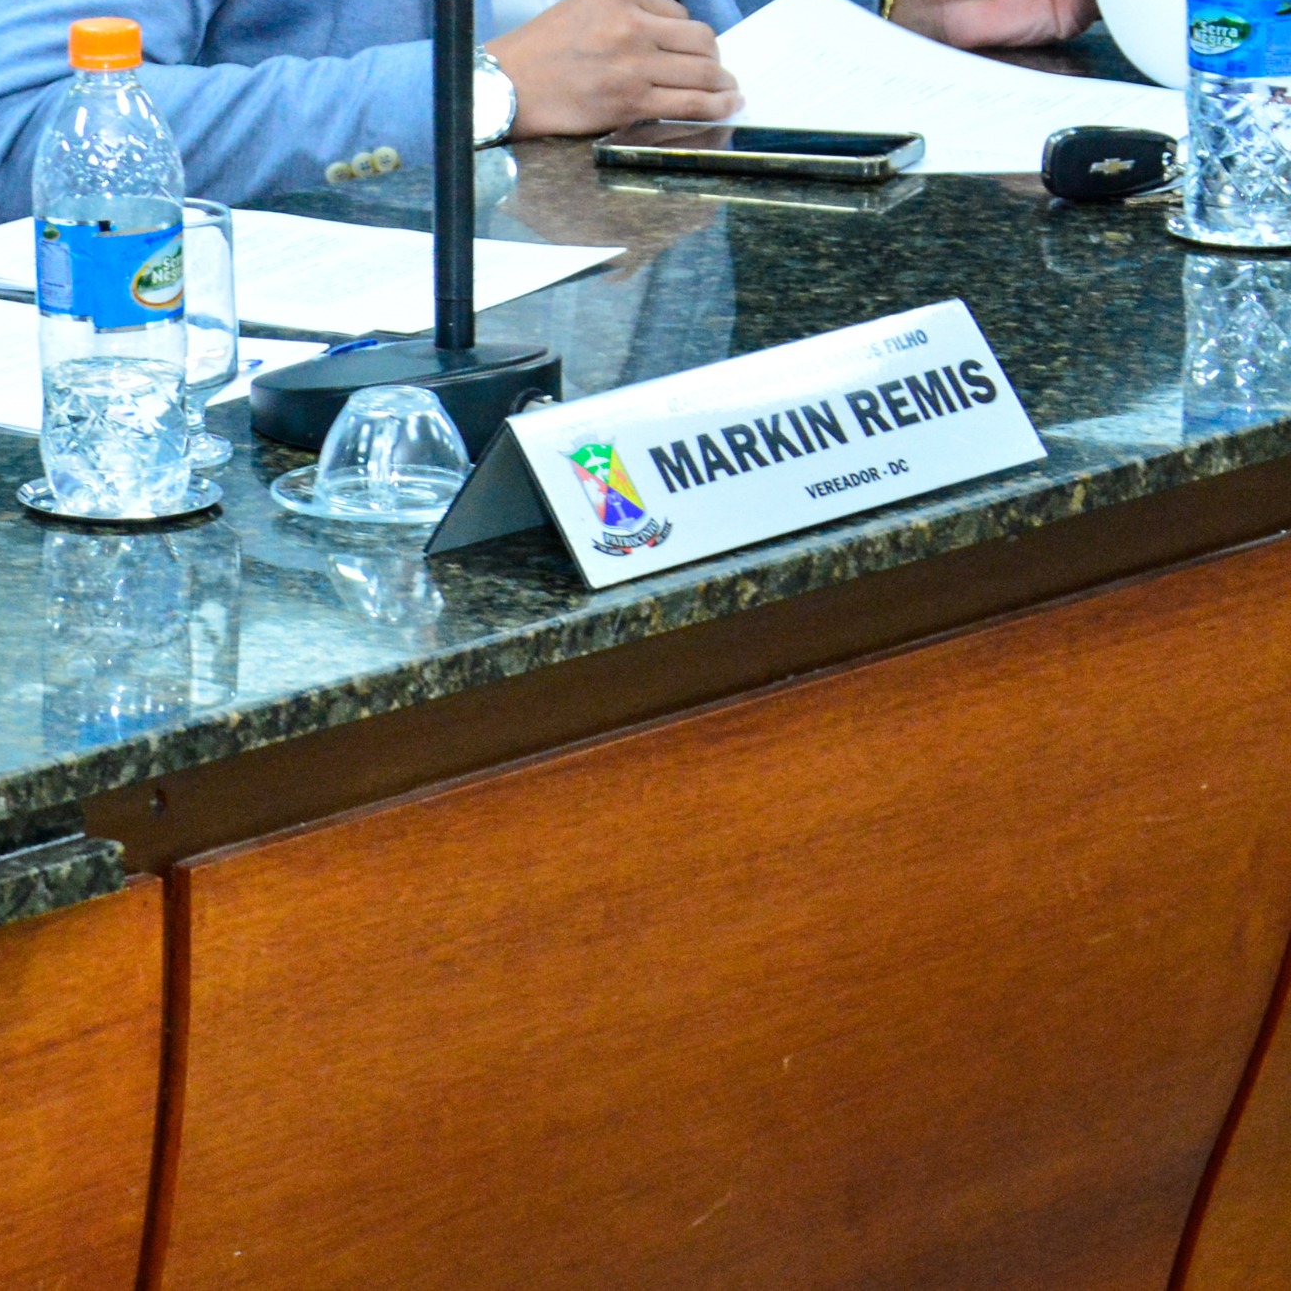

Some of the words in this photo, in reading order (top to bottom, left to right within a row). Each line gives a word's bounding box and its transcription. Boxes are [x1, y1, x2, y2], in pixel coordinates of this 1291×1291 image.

[884, 328, 928, 354] FILHO
[648, 400, 849, 494] MARKIN
[845, 359, 997, 438] REMIS
[805, 466, 881, 499] VEREADOR
[888, 458, 909, 476] DC
